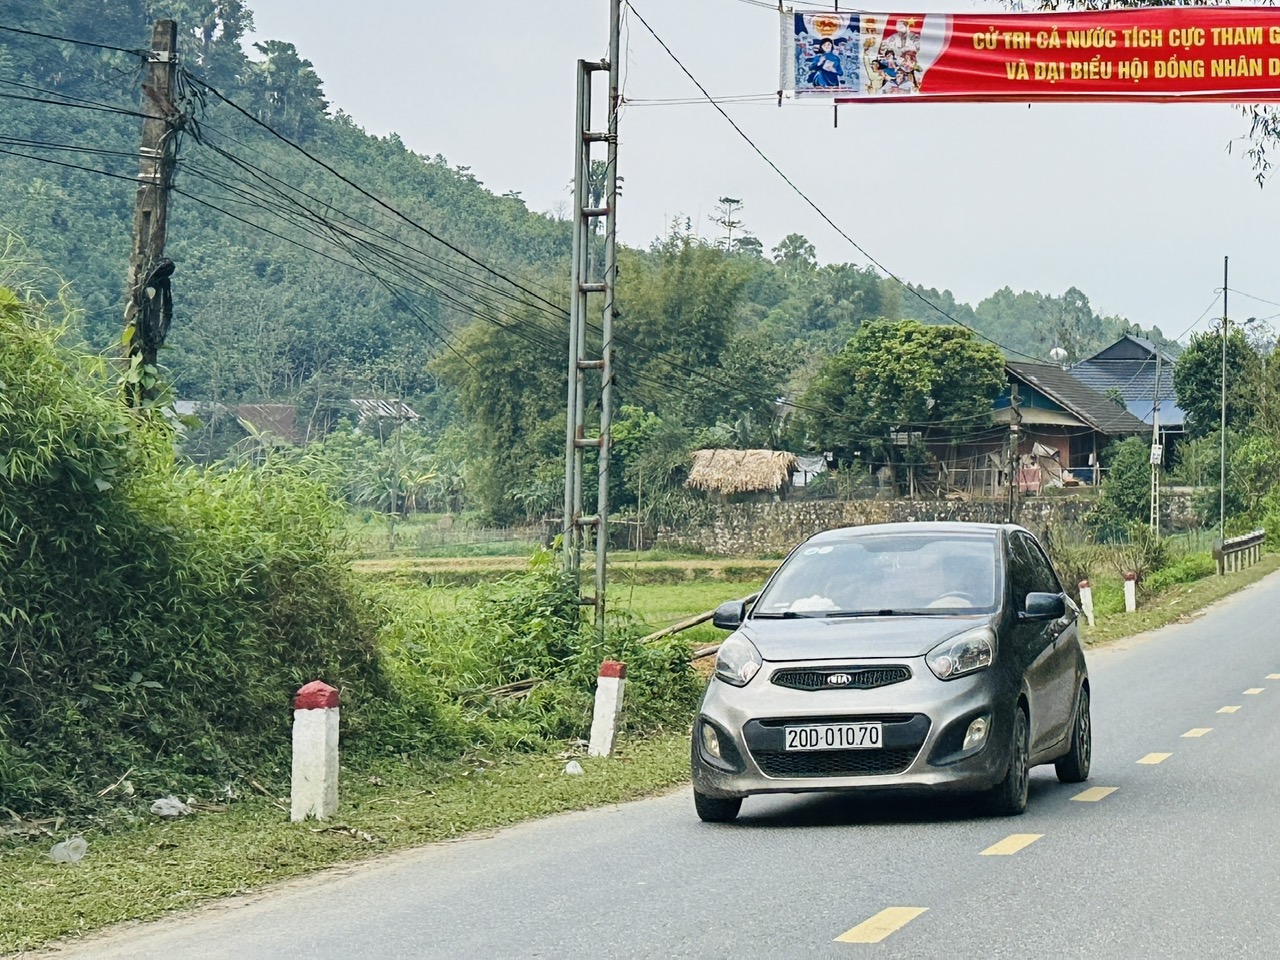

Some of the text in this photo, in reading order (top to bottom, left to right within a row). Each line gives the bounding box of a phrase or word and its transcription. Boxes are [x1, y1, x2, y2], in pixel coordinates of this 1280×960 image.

[973, 26, 999, 50] CỬ
[1002, 32, 1030, 49] TRI
[1037, 25, 1060, 49] CẢ
[1067, 27, 1116, 48] NƯỚC
[1122, 26, 1162, 48] TÍCH
[1169, 27, 1205, 50] CỰC
[1211, 27, 1263, 46] THAM
[1005, 59, 1029, 80] VÀ
[1034, 61, 1065, 84] ĐẠI
[1070, 54, 1112, 80] BIỂU
[1118, 58, 1148, 83] HỘI
[1154, 54, 1205, 78] ĐỒNG
[1211, 55, 1263, 78] NHÂN
